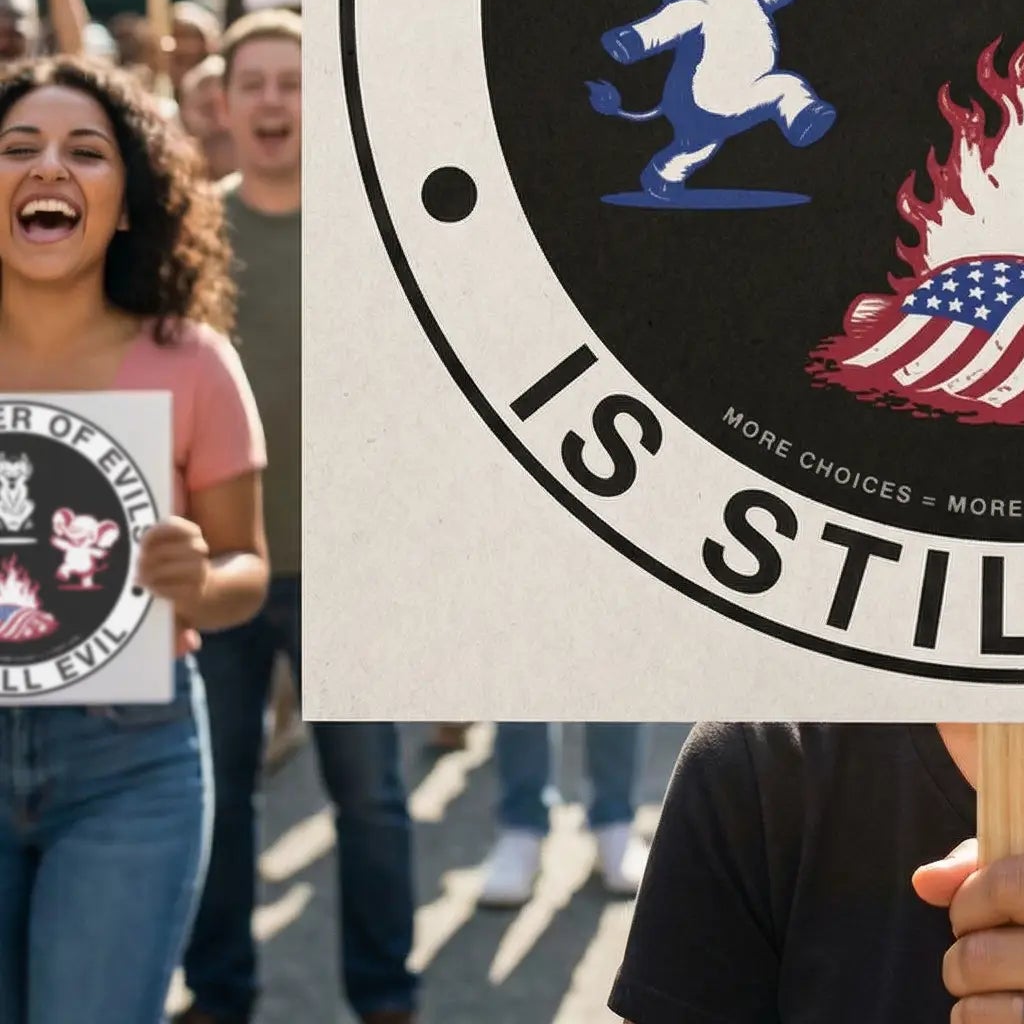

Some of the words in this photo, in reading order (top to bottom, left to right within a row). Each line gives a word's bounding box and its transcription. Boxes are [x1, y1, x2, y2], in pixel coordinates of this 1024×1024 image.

[48, 414, 95, 446] OF
[509, 343, 663, 498] IS
[722, 406, 793, 458] MORE
[799, 451, 912, 504] CHOICES
[947, 494, 1022, 518] MORE
[55, 627, 127, 682] EVIL
